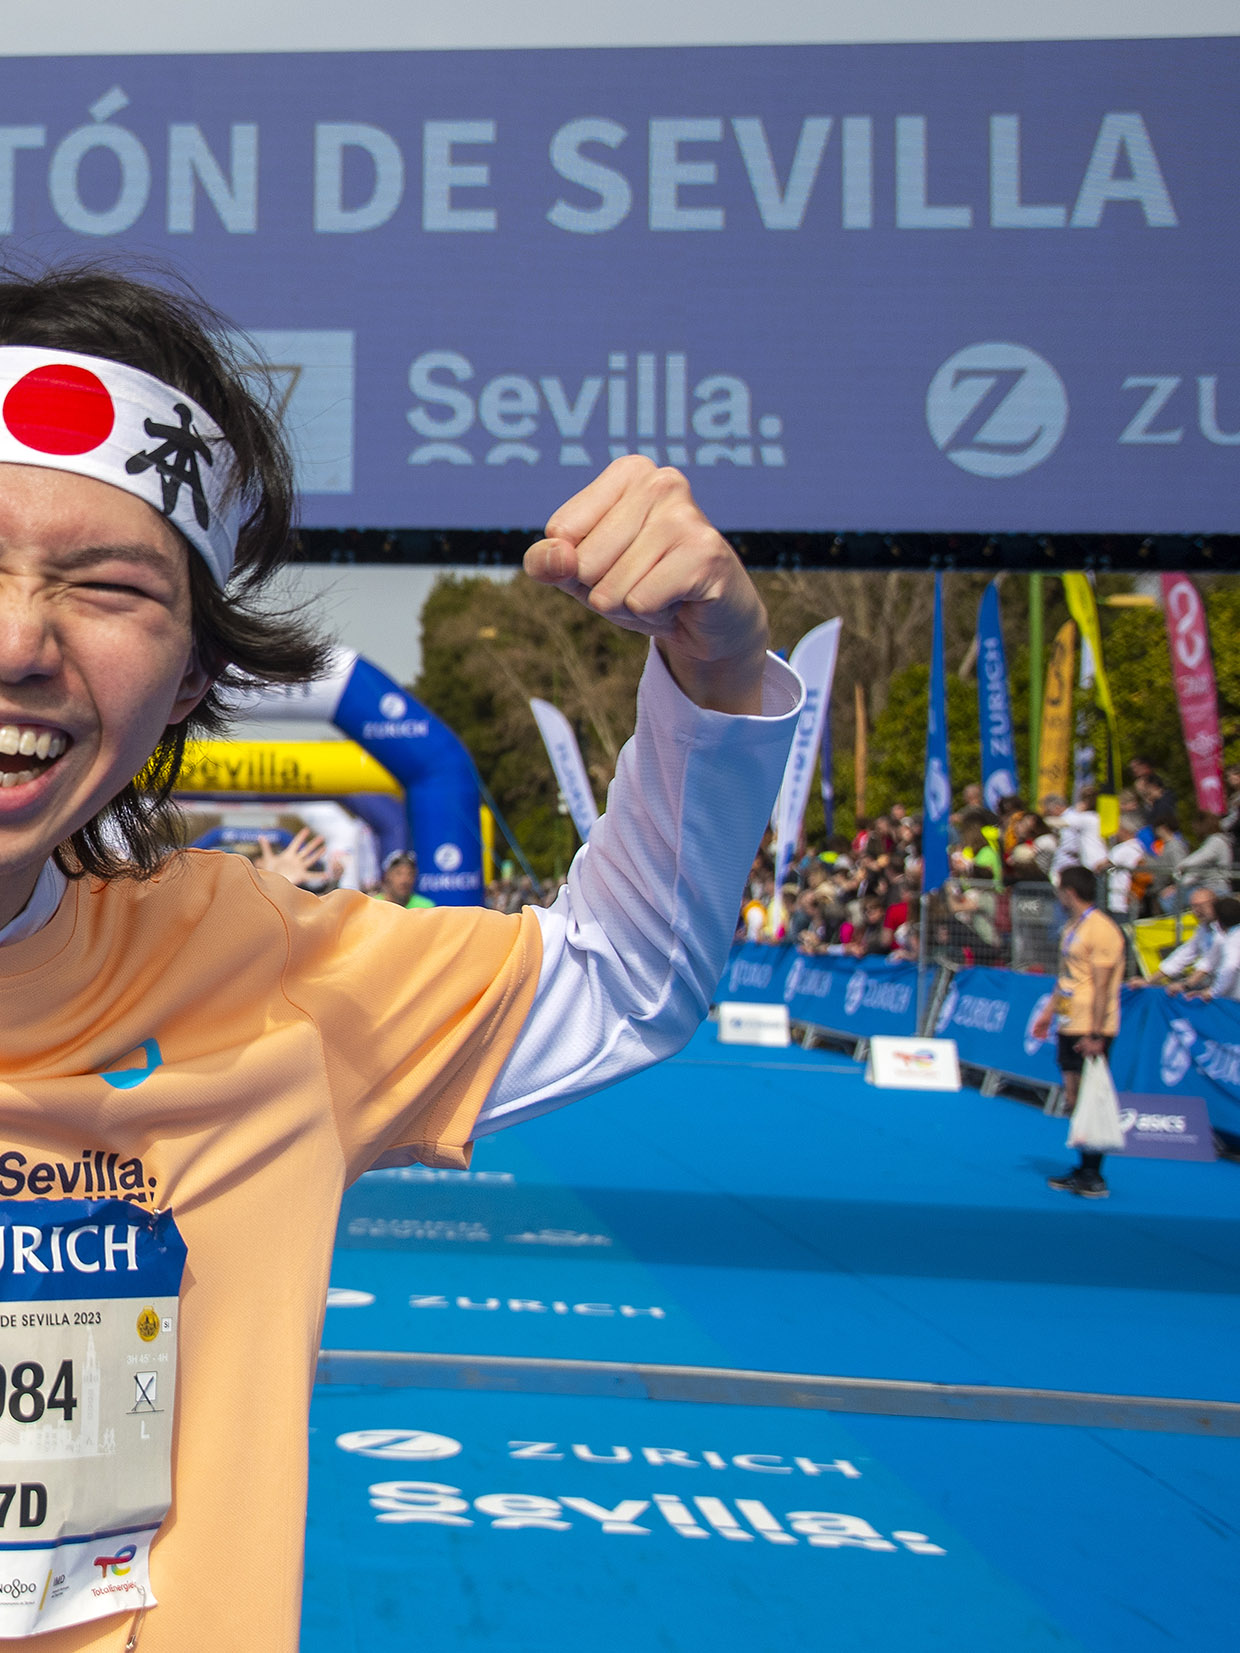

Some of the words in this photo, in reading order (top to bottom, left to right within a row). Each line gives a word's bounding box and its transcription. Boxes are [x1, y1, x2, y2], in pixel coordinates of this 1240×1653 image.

[313, 119, 498, 233] DE
[545, 112, 1179, 235] SEVILLA
[124, 402, 214, 531] 本
[983, 637, 1010, 757] ZURICH
[193, 751, 313, 780] evilla.
[0, 1315, 16, 1327] DE
[21, 1313, 69, 1327] SEVILLA
[73, 1312, 102, 1325] 2023
[409, 1295, 666, 1319] ZURICH
[140, 1420, 151, 1440] L
[506, 1440, 863, 1478] ZURICH
